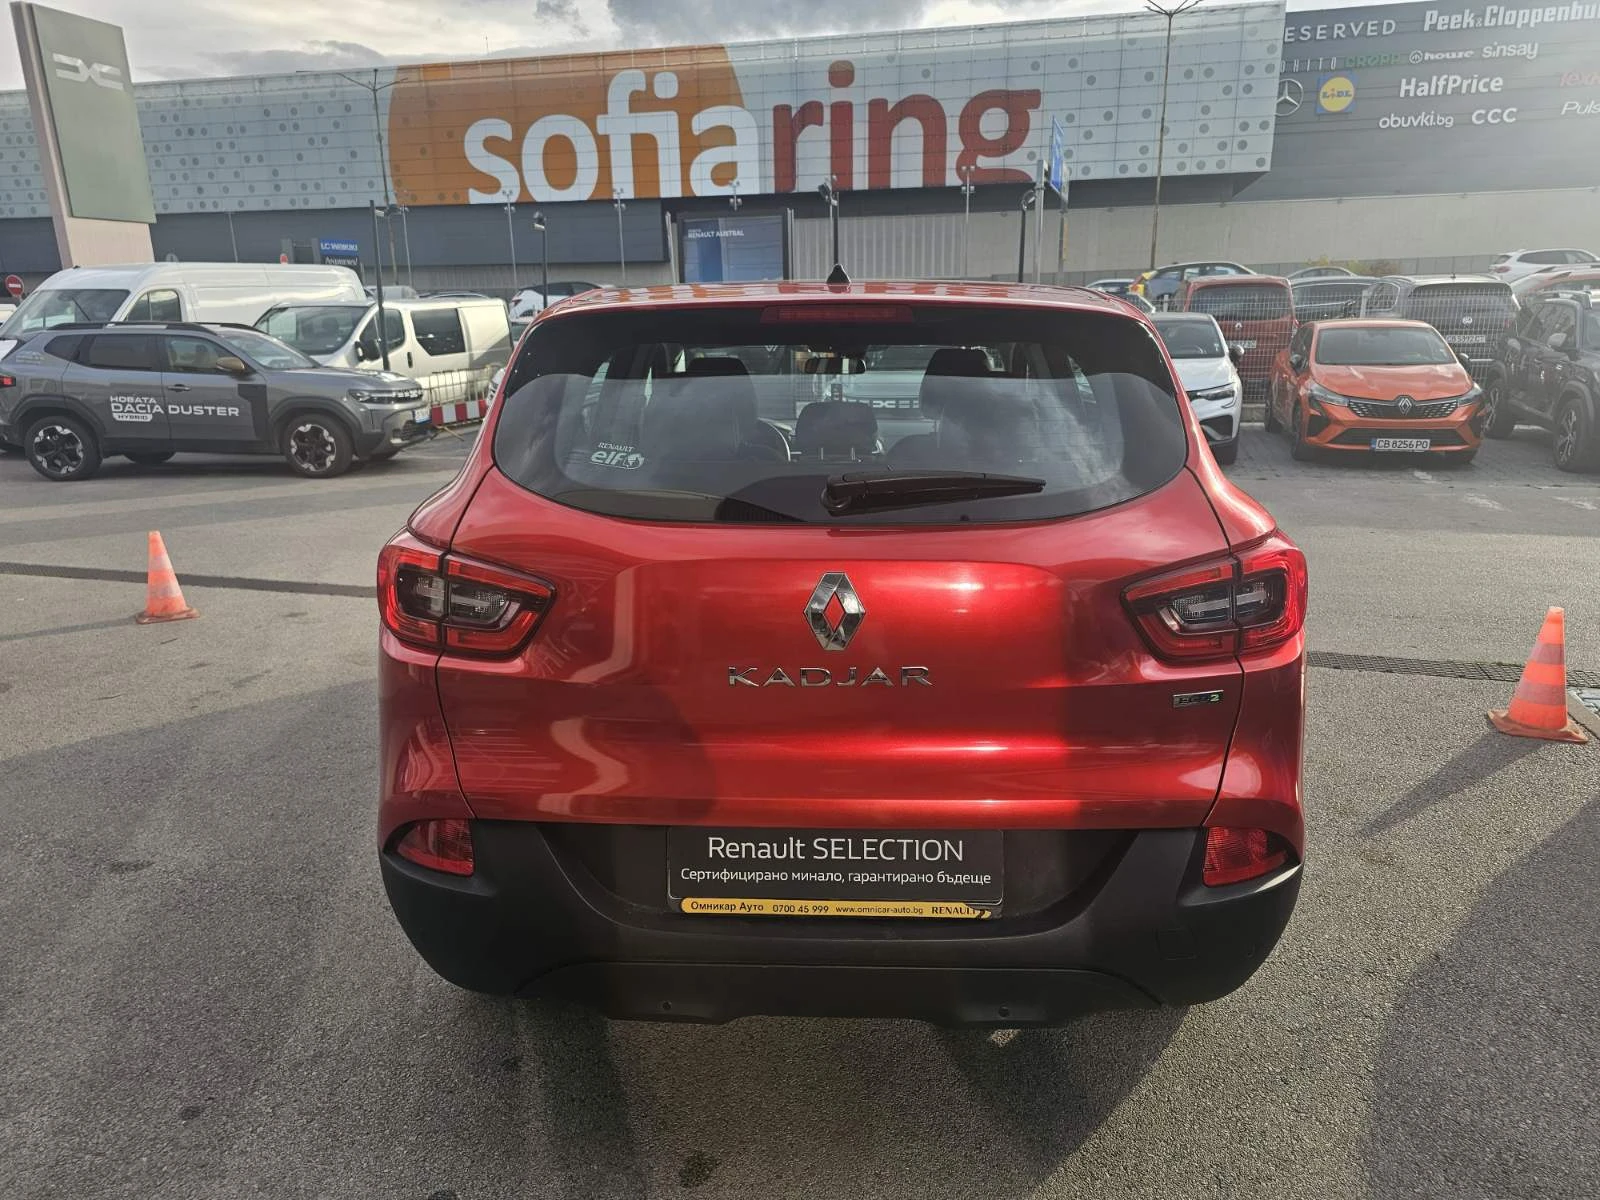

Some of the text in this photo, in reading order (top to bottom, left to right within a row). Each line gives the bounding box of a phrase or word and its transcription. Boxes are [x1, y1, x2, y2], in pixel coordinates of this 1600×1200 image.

[1284, 20, 1396, 42] ESERVED
[1482, 42, 1539, 60] sinsay
[1281, 57, 1337, 73] OHITO
[1379, 111, 1455, 128] obuvki.bg
[1472, 107, 1518, 125] CCC
[111, 402, 240, 416] DACIA DUSTER
[1392, 440, 1414, 448] 8256
[591, 451, 627, 465] elf
[728, 666, 935, 687] KADJAR
[708, 836, 963, 861] Renault SELECTION
[681, 868, 991, 885] Сертифицирано минало, гарантирано бъдеще
[691, 902, 737, 912] Омникар
[739, 902, 764, 912] Ауто
[772, 905, 796, 913] 0700
[797, 905, 809, 913] 45
[812, 905, 829, 913] 999
[835, 906, 923, 915] www.omnicar-auto.bg
